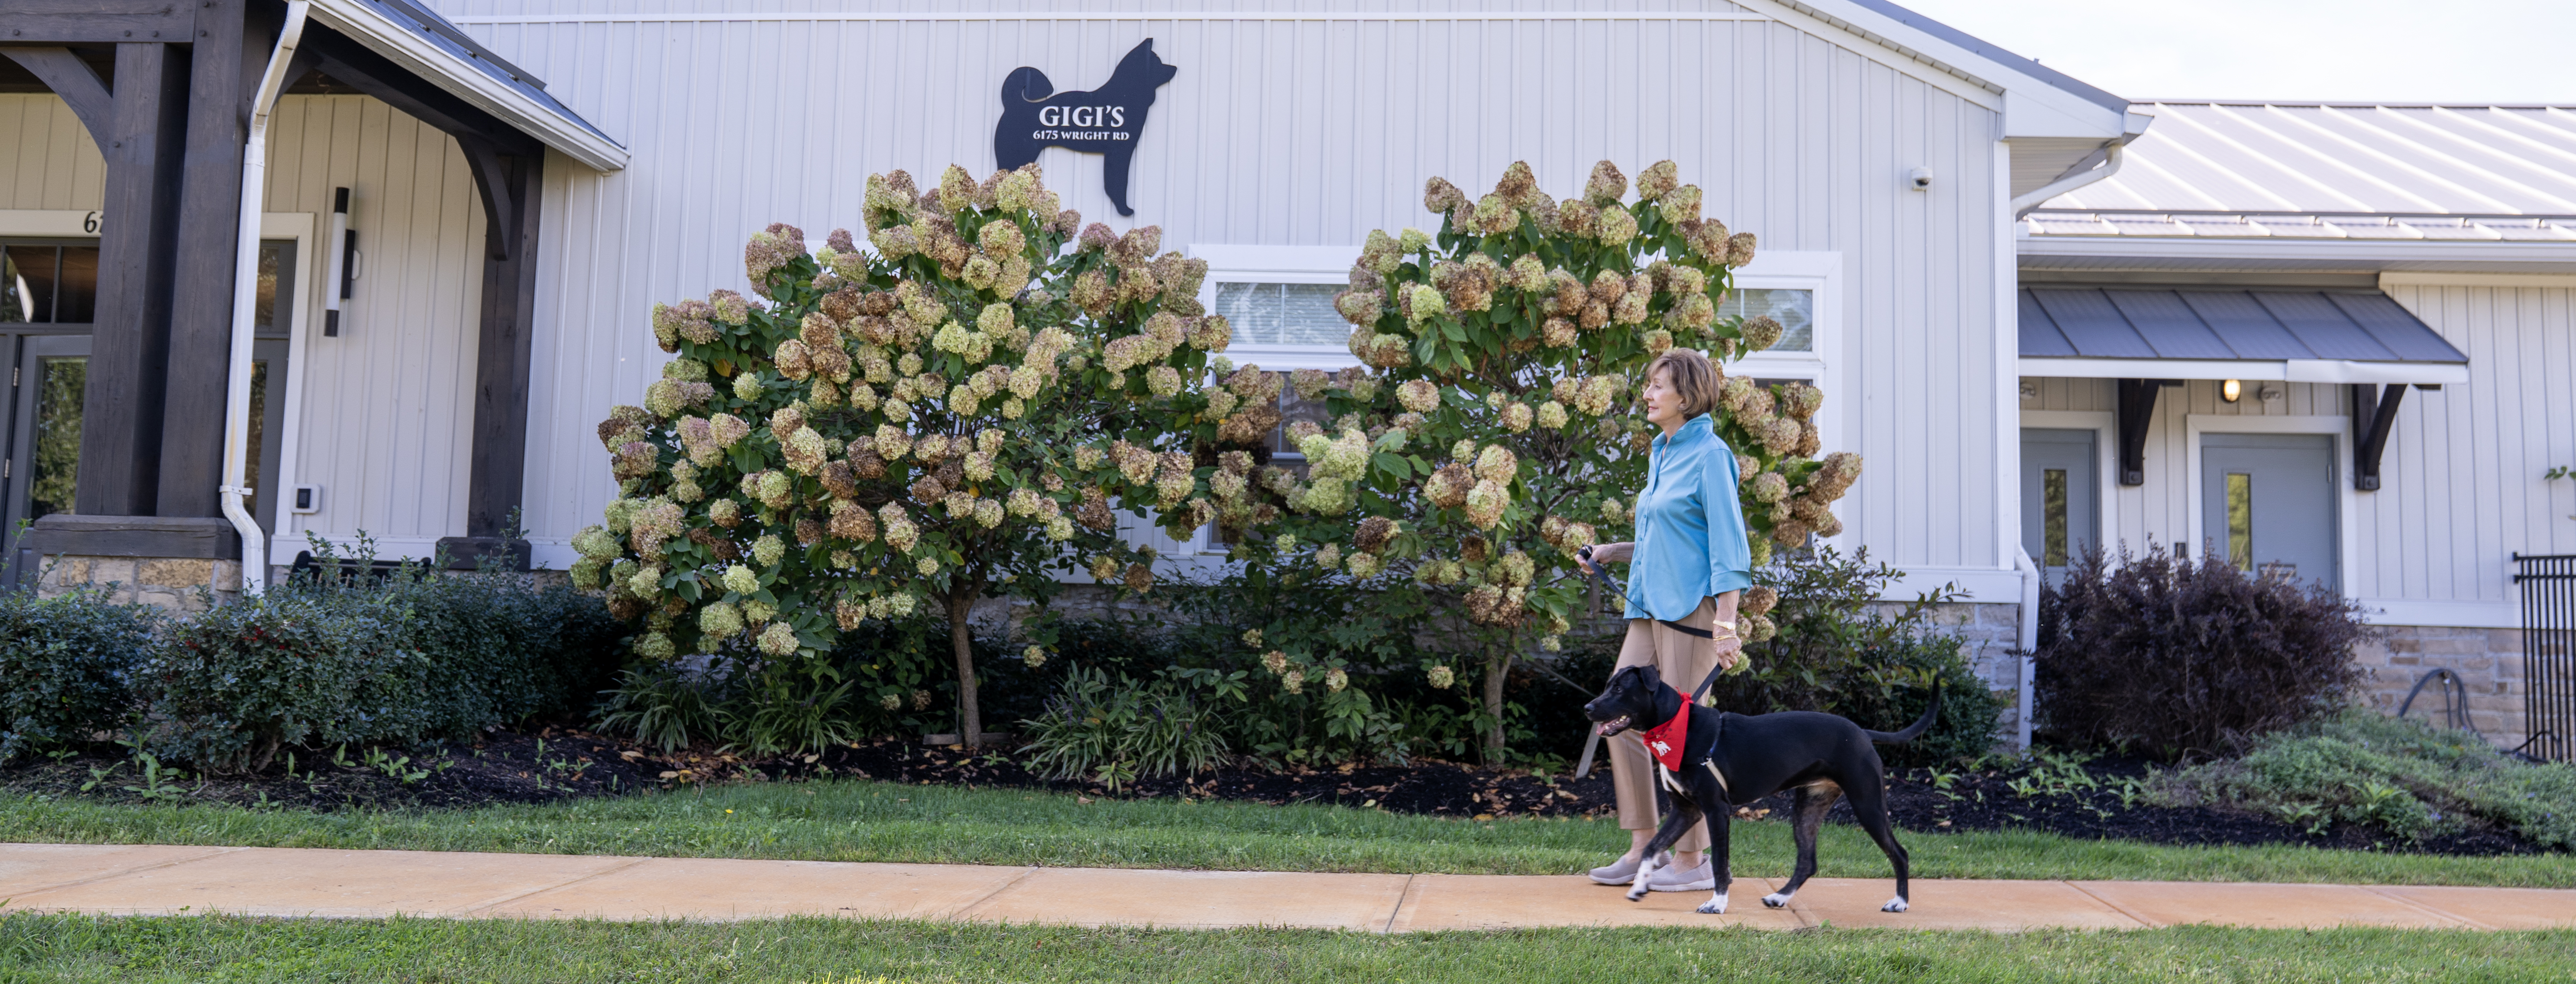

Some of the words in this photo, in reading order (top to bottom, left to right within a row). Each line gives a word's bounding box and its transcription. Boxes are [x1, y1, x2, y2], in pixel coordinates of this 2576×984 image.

[1032, 130, 1058, 139] 6175
[1061, 131, 1110, 140] WRIGHT
[1112, 131, 1129, 140] RD
